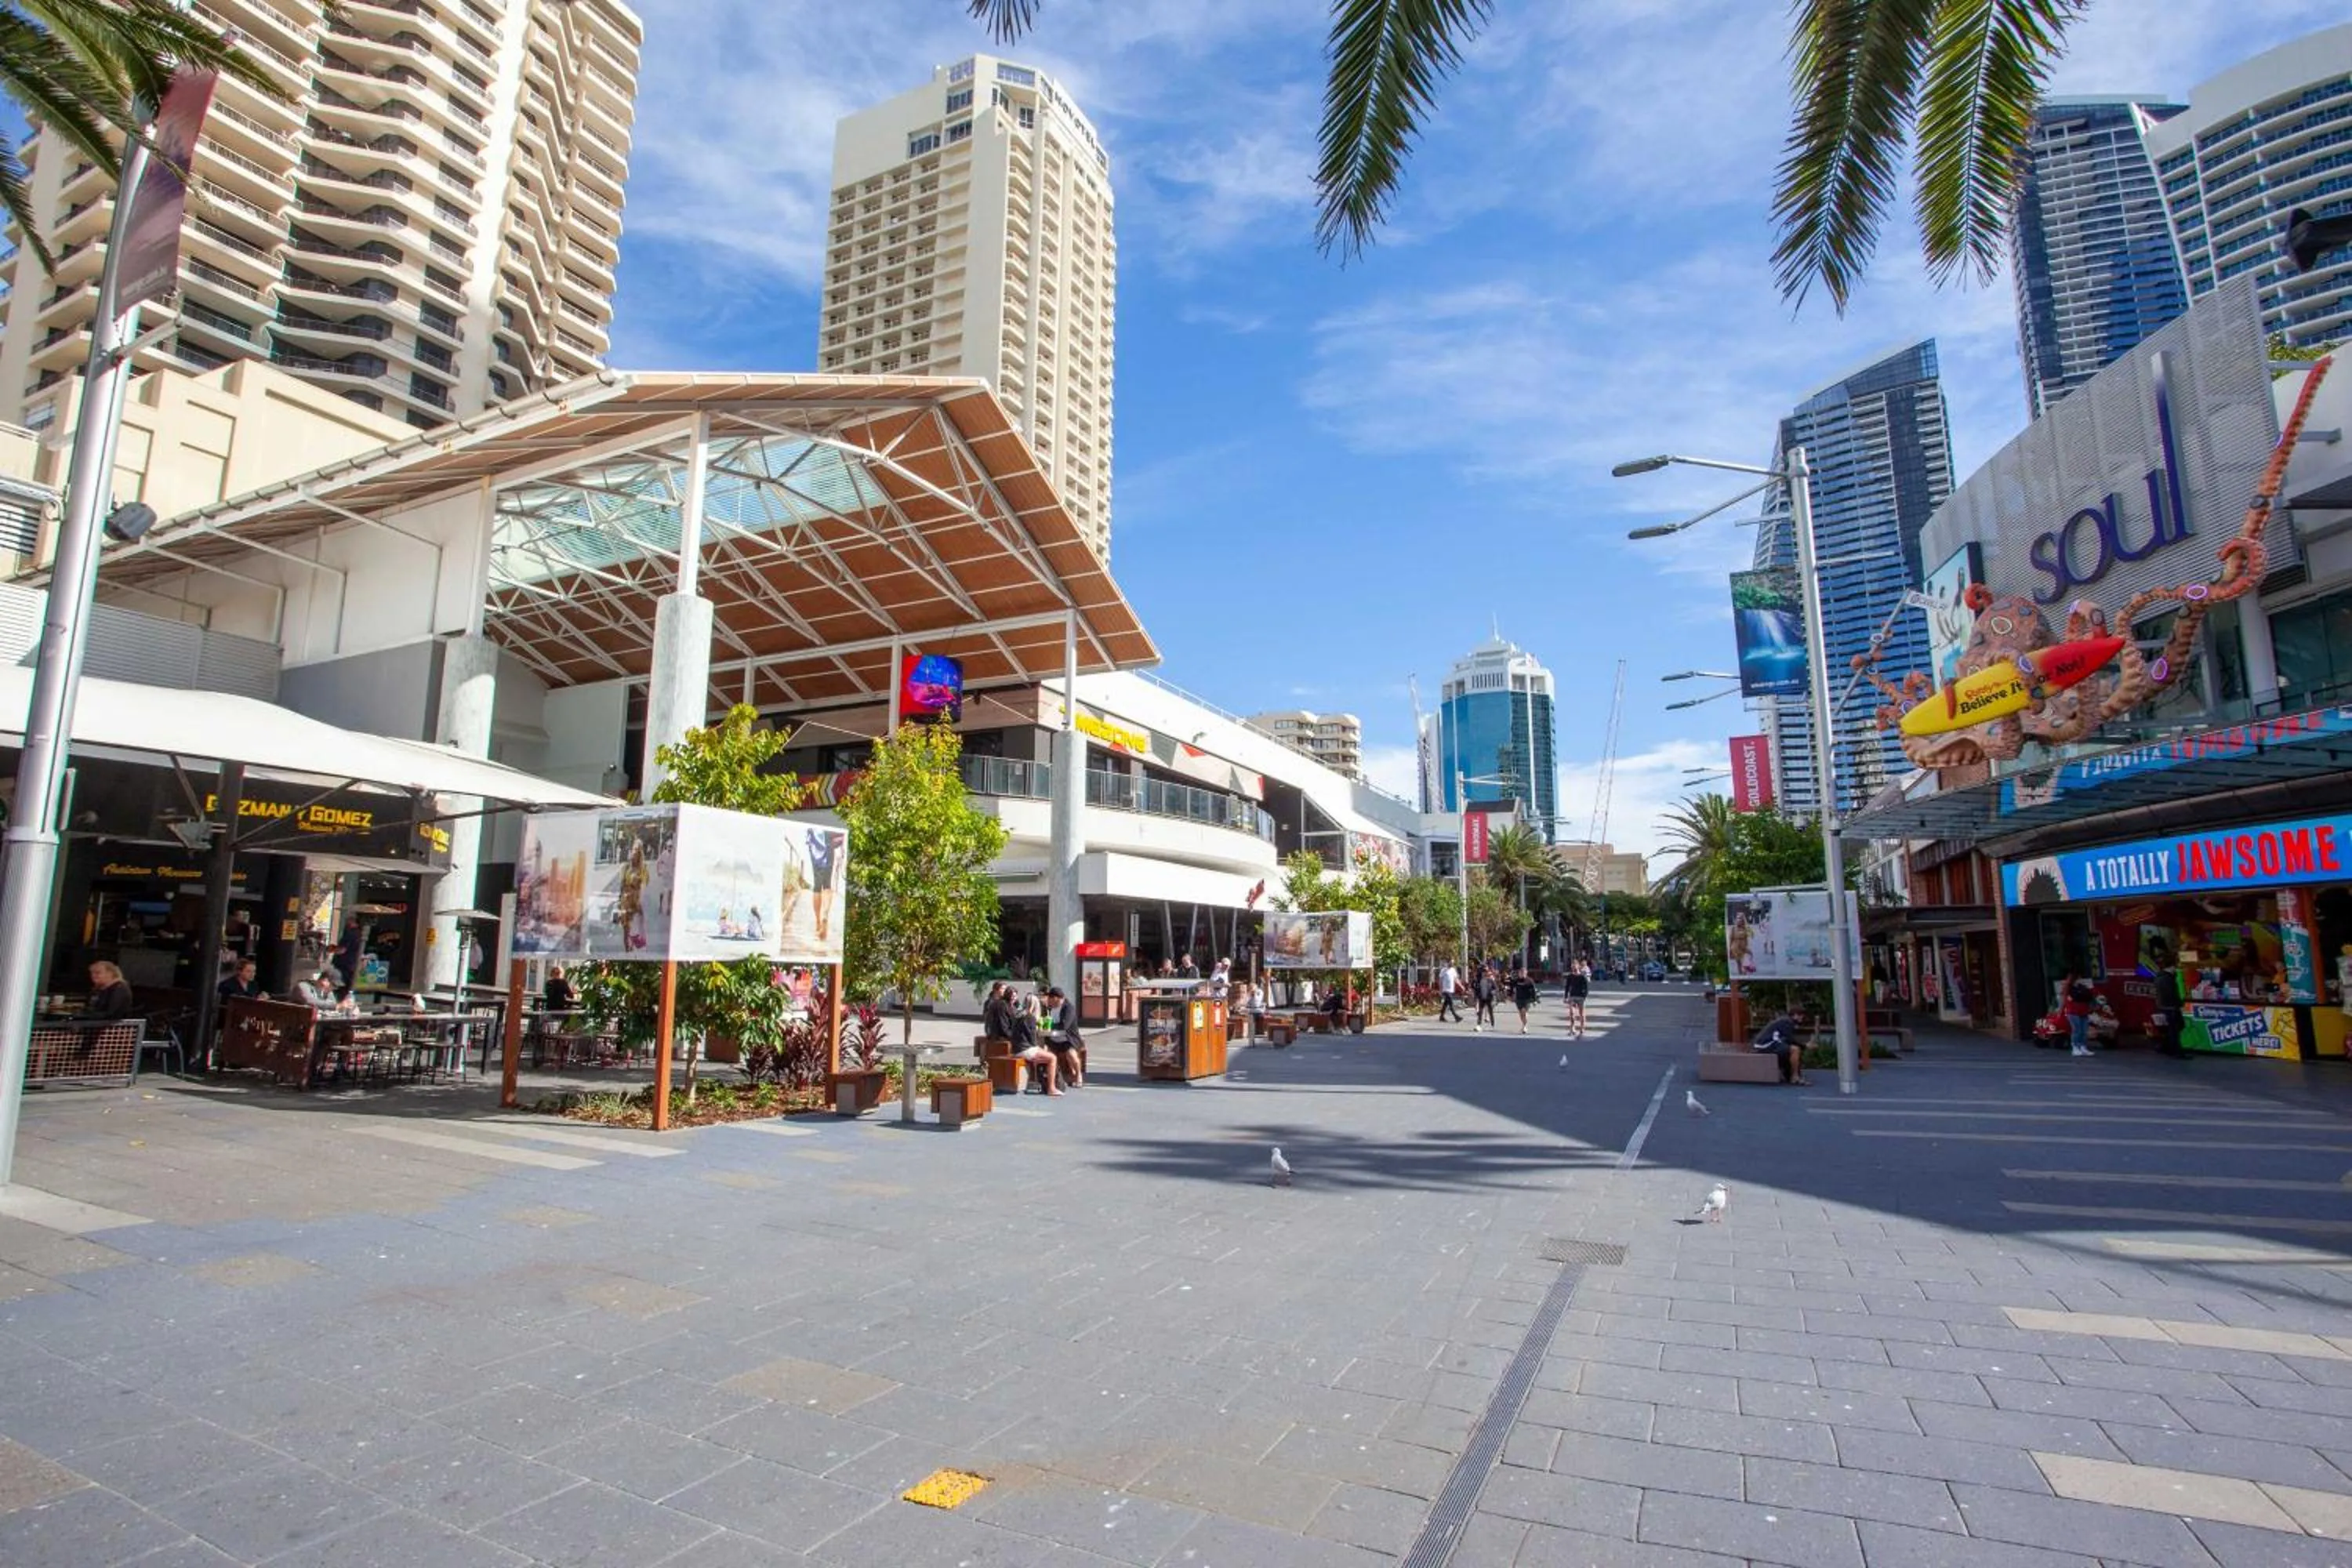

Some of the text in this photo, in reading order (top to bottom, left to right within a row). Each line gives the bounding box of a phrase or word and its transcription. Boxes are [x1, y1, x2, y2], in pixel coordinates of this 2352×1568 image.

[2030, 350, 2196, 605] soul
[1960, 690, 2008, 714] Believe
[2011, 681, 2024, 695] It
[206, 793, 292, 819] GZMAN
[309, 804, 374, 829] GOMEZ
[2085, 824, 2340, 891] A TOTALLY JAWSOME
[2212, 1014, 2264, 1042] TICKETS
